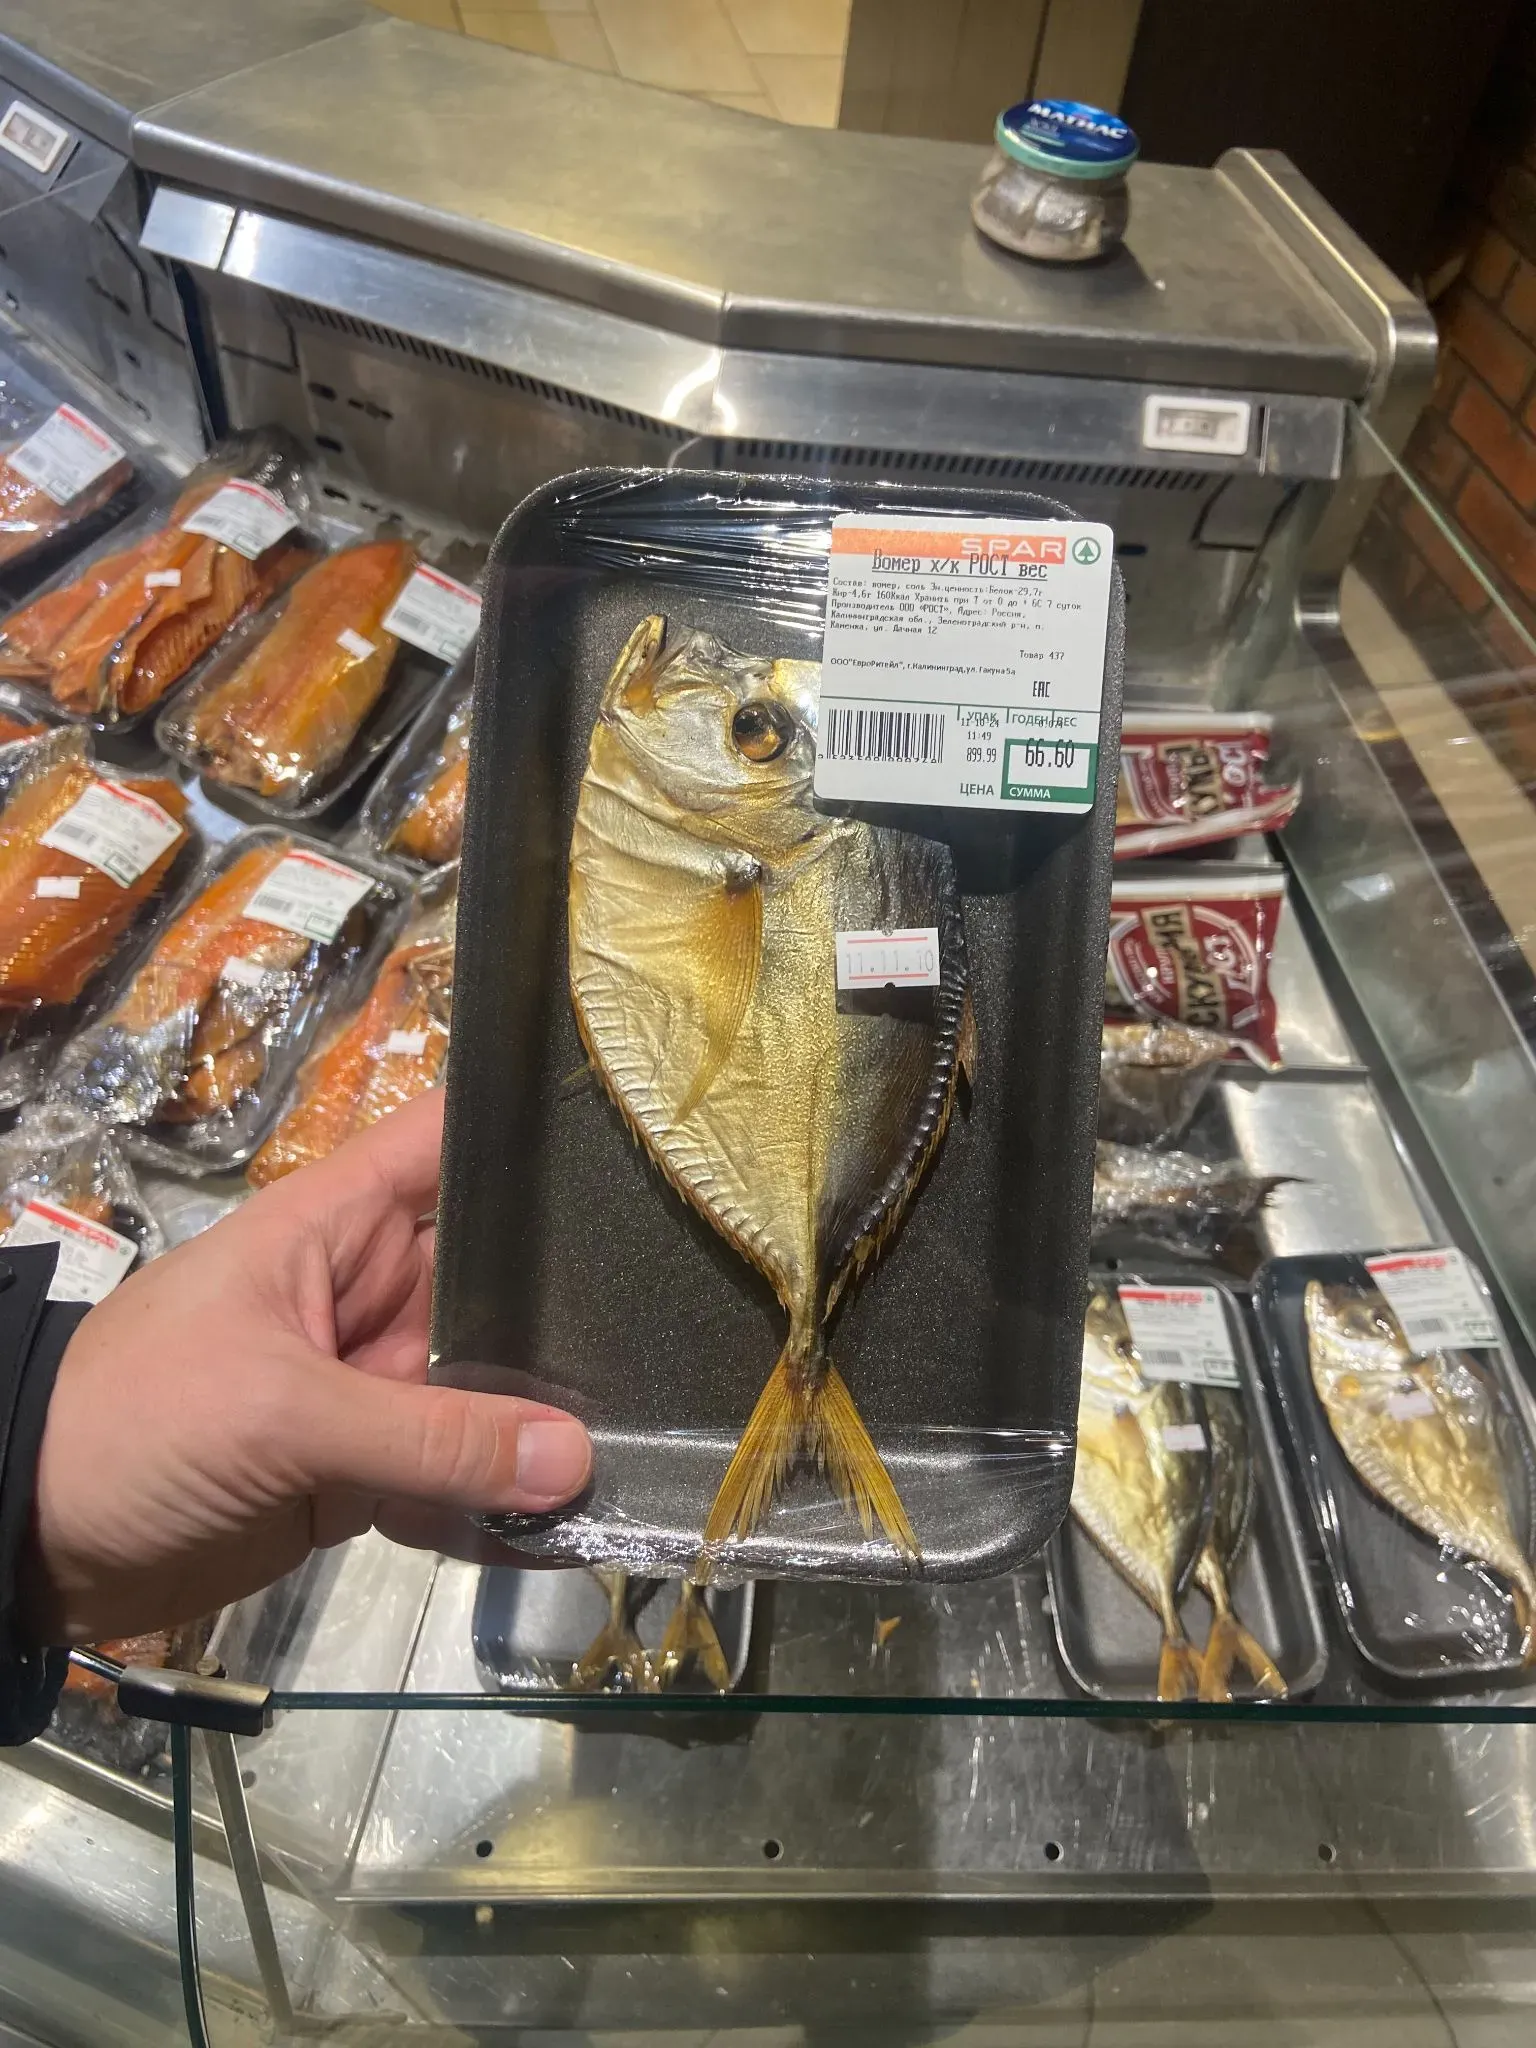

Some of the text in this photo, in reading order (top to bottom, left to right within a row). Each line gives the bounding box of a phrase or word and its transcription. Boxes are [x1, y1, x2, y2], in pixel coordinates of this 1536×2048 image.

[961, 537, 1063, 560] SPAR
[872, 549, 921, 574] Вомер
[969, 553, 1009, 576] РОСТ
[1018, 564, 1048, 579] вес
[832, 577, 867, 587] Состав:
[831, 599, 895, 612] Производитель
[899, 603, 914, 612] ООО
[914, 592, 949, 604] Хранить
[954, 597, 969, 605] при
[1008, 600, 1018, 608] до
[1056, 602, 1081, 611] суток
[830, 620, 868, 631] Каменка,
[893, 624, 922, 635] Дачная
[927, 626, 938, 635] 12
[938, 615, 1007, 628] Зеленоградский
[1019, 650, 1044, 660] Товар
[966, 747, 997, 763] 899.99
[1025, 738, 1075, 768] 66.60
[959, 783, 1051, 799] ЦЕНА СУММА
